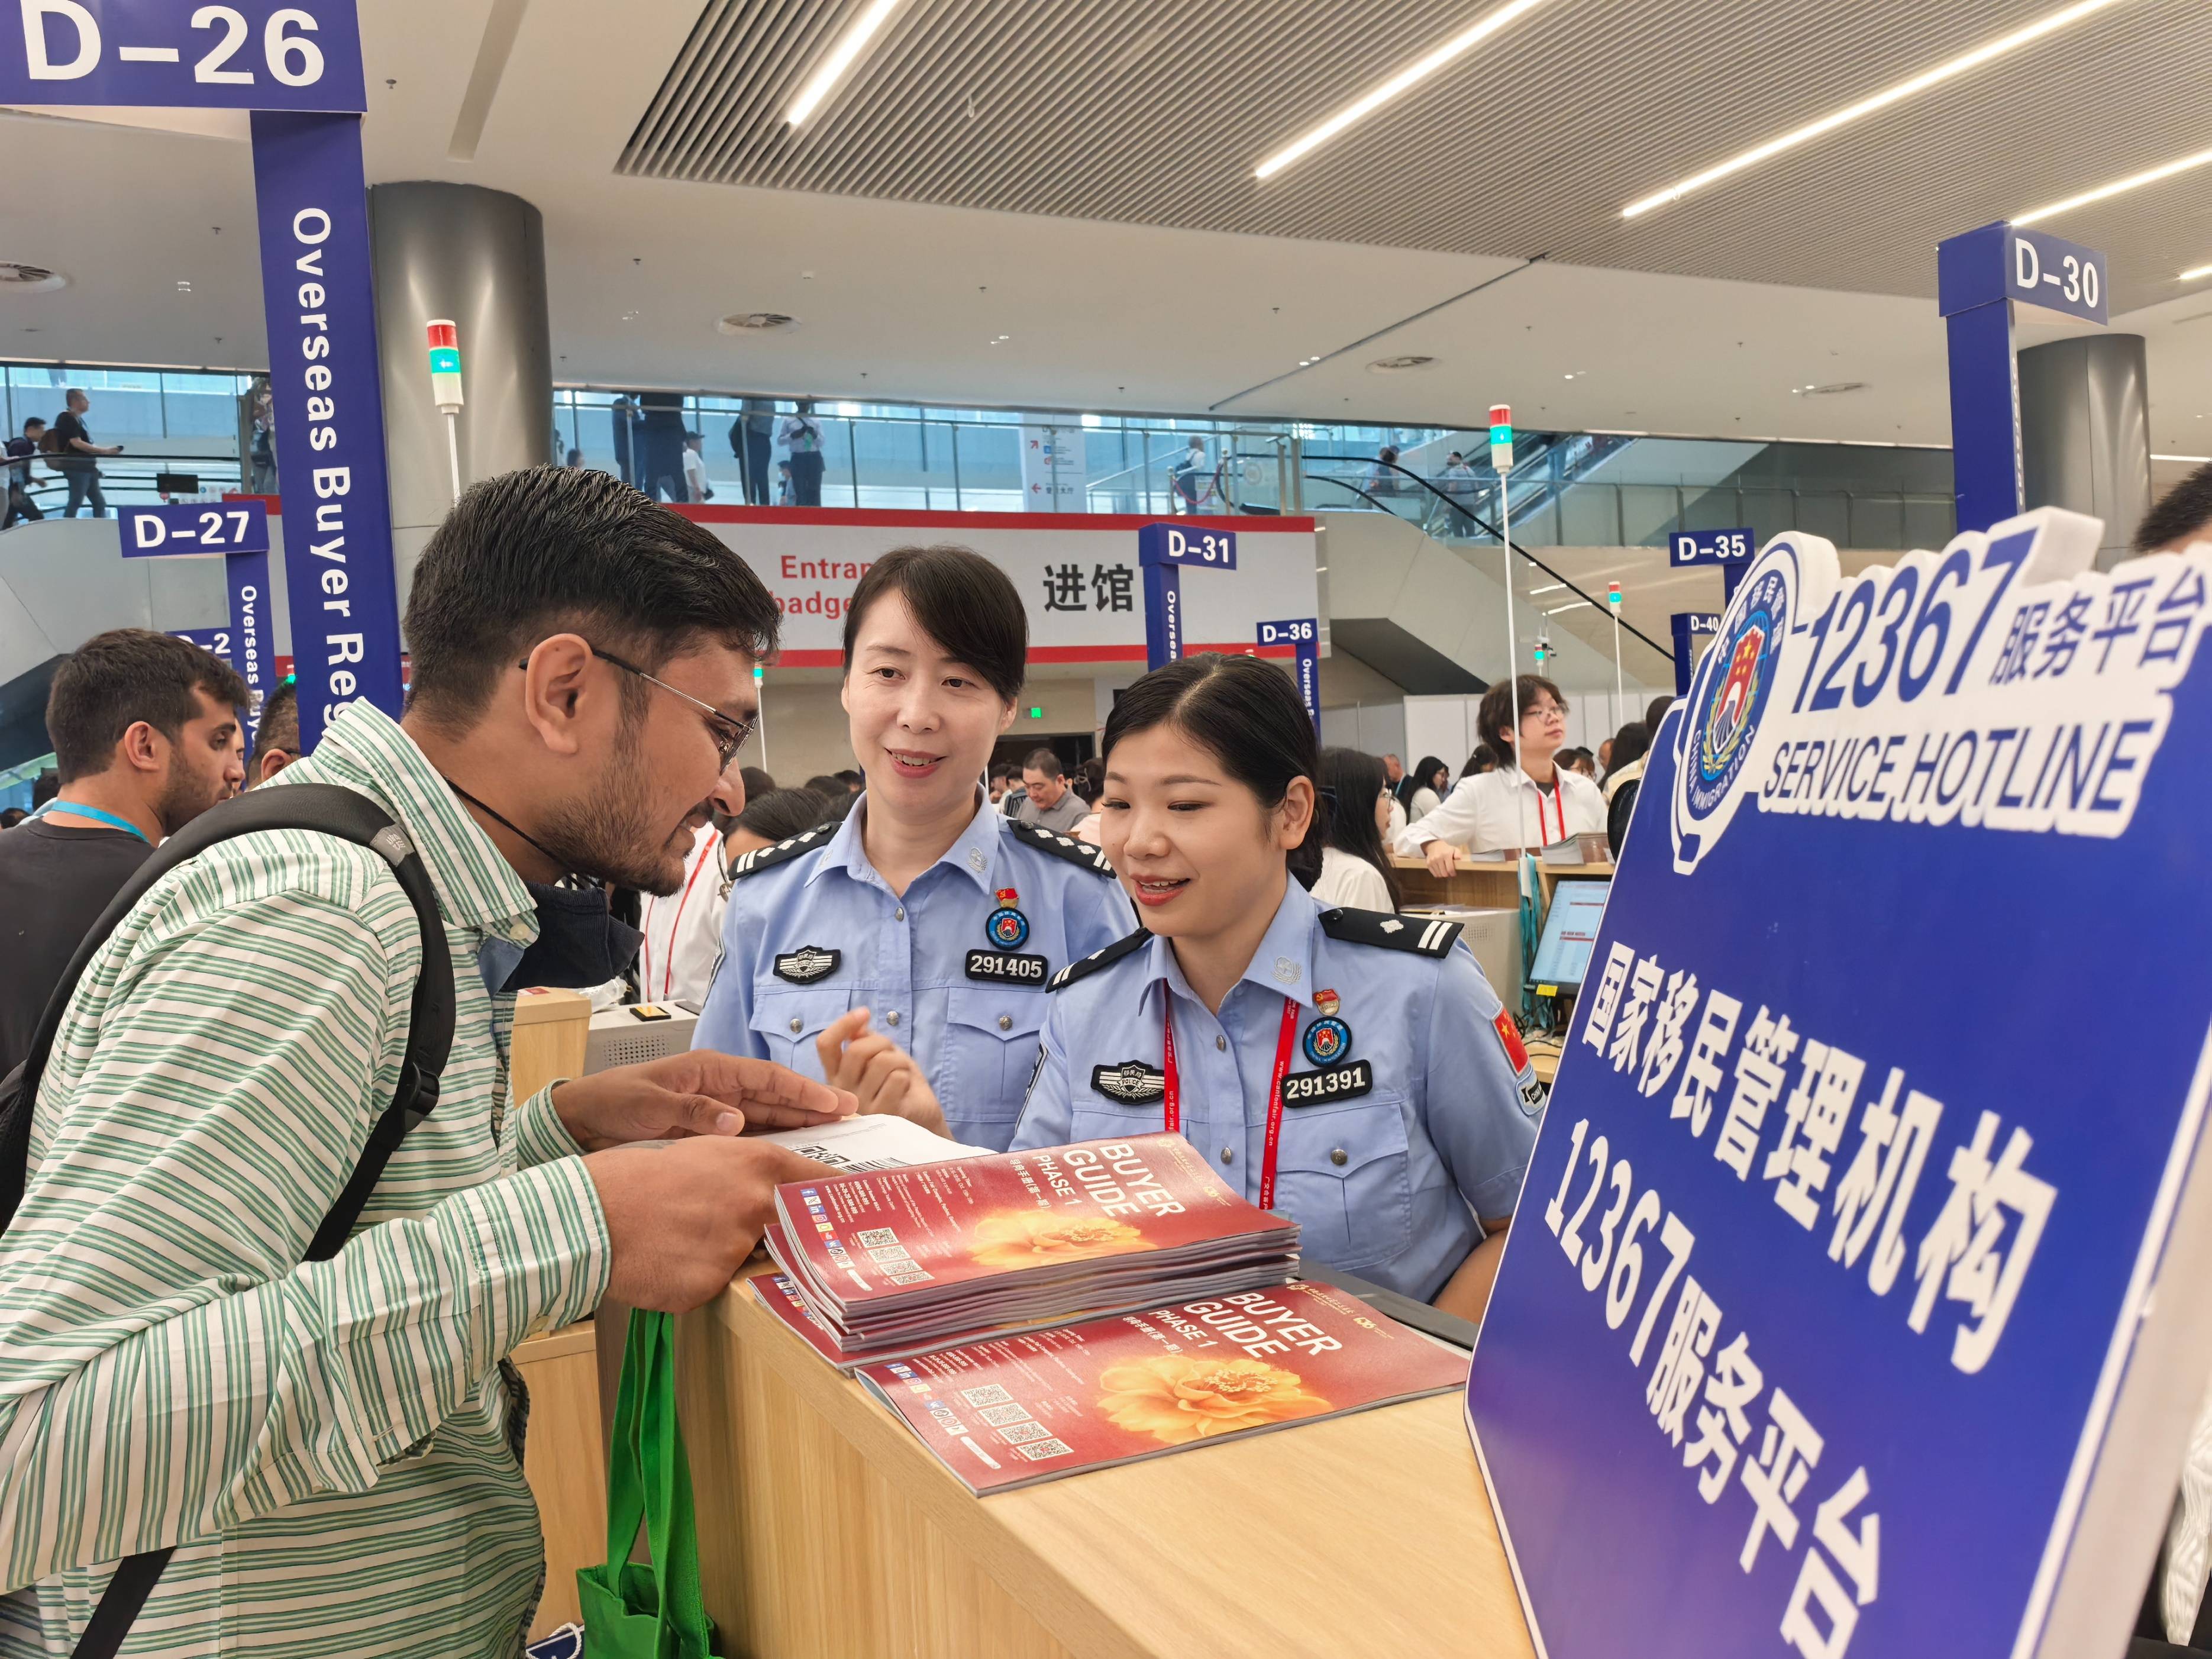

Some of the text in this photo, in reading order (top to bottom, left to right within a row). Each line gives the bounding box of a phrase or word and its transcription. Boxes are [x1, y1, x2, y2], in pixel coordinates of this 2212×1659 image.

[20, 0, 324, 86] D-26
[2014, 238, 2099, 308] D-30
[293, 207, 337, 451] Overseas
[134, 511, 250, 548] D-27
[309, 466, 350, 618] Buyer
[1168, 530, 1229, 563] D-31
[1678, 535, 1746, 561] D-35
[1043, 563, 1134, 612] 进馆
[1792, 528, 2036, 714] 12367
[241, 585, 259, 685] Overseas
[1262, 623, 1312, 643] D-36
[1691, 615, 1719, 632] D-40
[1990, 566, 2205, 686] 服务平台
[1691, 724, 1755, 811] IMMIGRATION
[1764, 719, 2154, 813] SERVICE HOTLINE
[970, 954, 1042, 979] 291405
[1268, 1060, 1284, 1146] www.cantonfair.org.cn
[1286, 1067, 1365, 1099] 291391
[1032, 1155, 1076, 1197] PHASE
[1063, 1150, 1141, 1217] GUIDE
[1099, 1143, 1186, 1217] BUYER
[1581, 940, 2059, 1374] 国家移民管理机构
[1147, 1310, 1208, 1341] PHASE
[1183, 1302, 1292, 1358] GUIDE
[1222, 1292, 1343, 1356] BUYER
